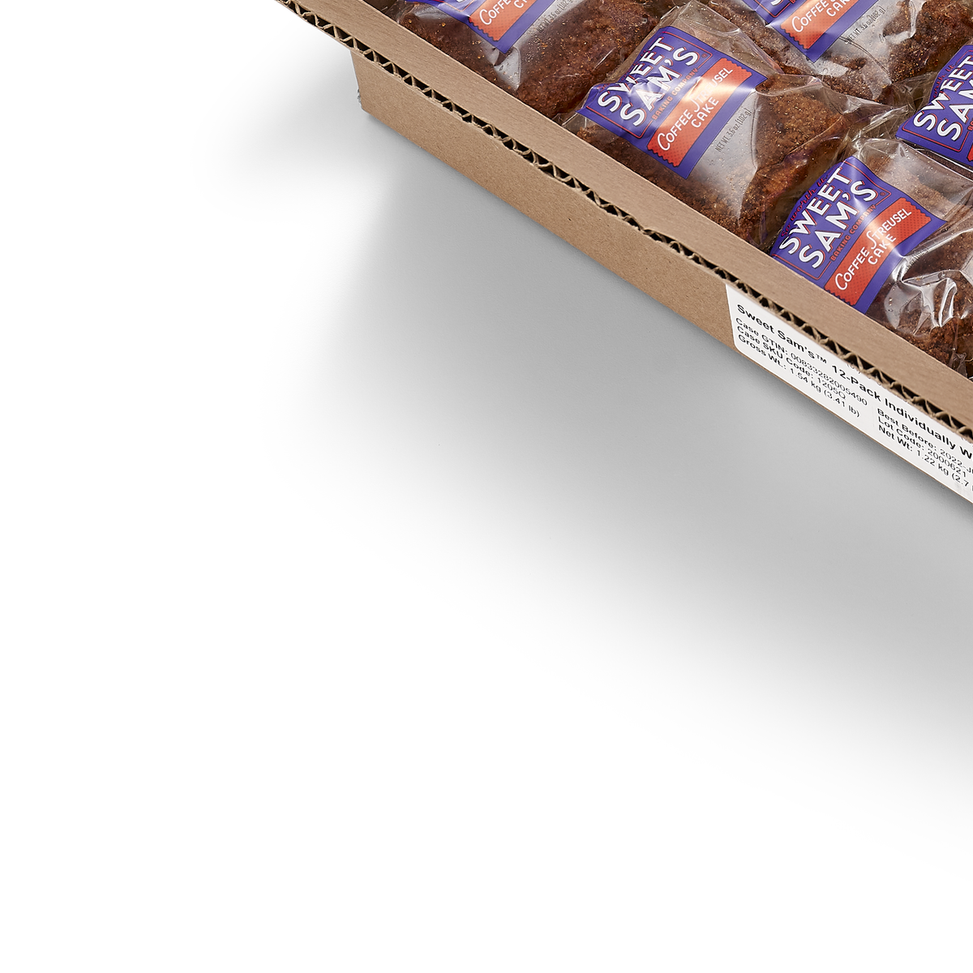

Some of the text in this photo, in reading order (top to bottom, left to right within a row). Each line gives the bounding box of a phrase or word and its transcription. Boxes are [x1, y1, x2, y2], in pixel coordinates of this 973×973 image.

[620, 47, 698, 126] SAM'S
[657, 109, 693, 151] COFFEE
[692, 97, 719, 128] CAKE
[779, 168, 850, 254] SWEET
[799, 181, 877, 269] SAM'S
[835, 208, 912, 290] COFFEE STREUSEL
[868, 234, 896, 265] CAKE
[736, 318, 759, 336] Case
[762, 335, 788, 355] GTIN:
[737, 326, 760, 344] Case
[763, 342, 783, 358] SKU
[786, 358, 813, 378] Code:
[737, 304, 775, 334] Sweet
[832, 366, 881, 401] 12-Pack
[885, 398, 956, 449] Individually
[739, 334, 766, 356] Gross
[811, 381, 821, 392] kg
[849, 405, 859, 417] lb)
[878, 408, 899, 426] Best
[902, 424, 936, 451] Before:
[878, 416, 893, 430] Lot
[896, 429, 924, 450] Code:
[879, 425, 895, 439] Net
[938, 464, 949, 476] kg
